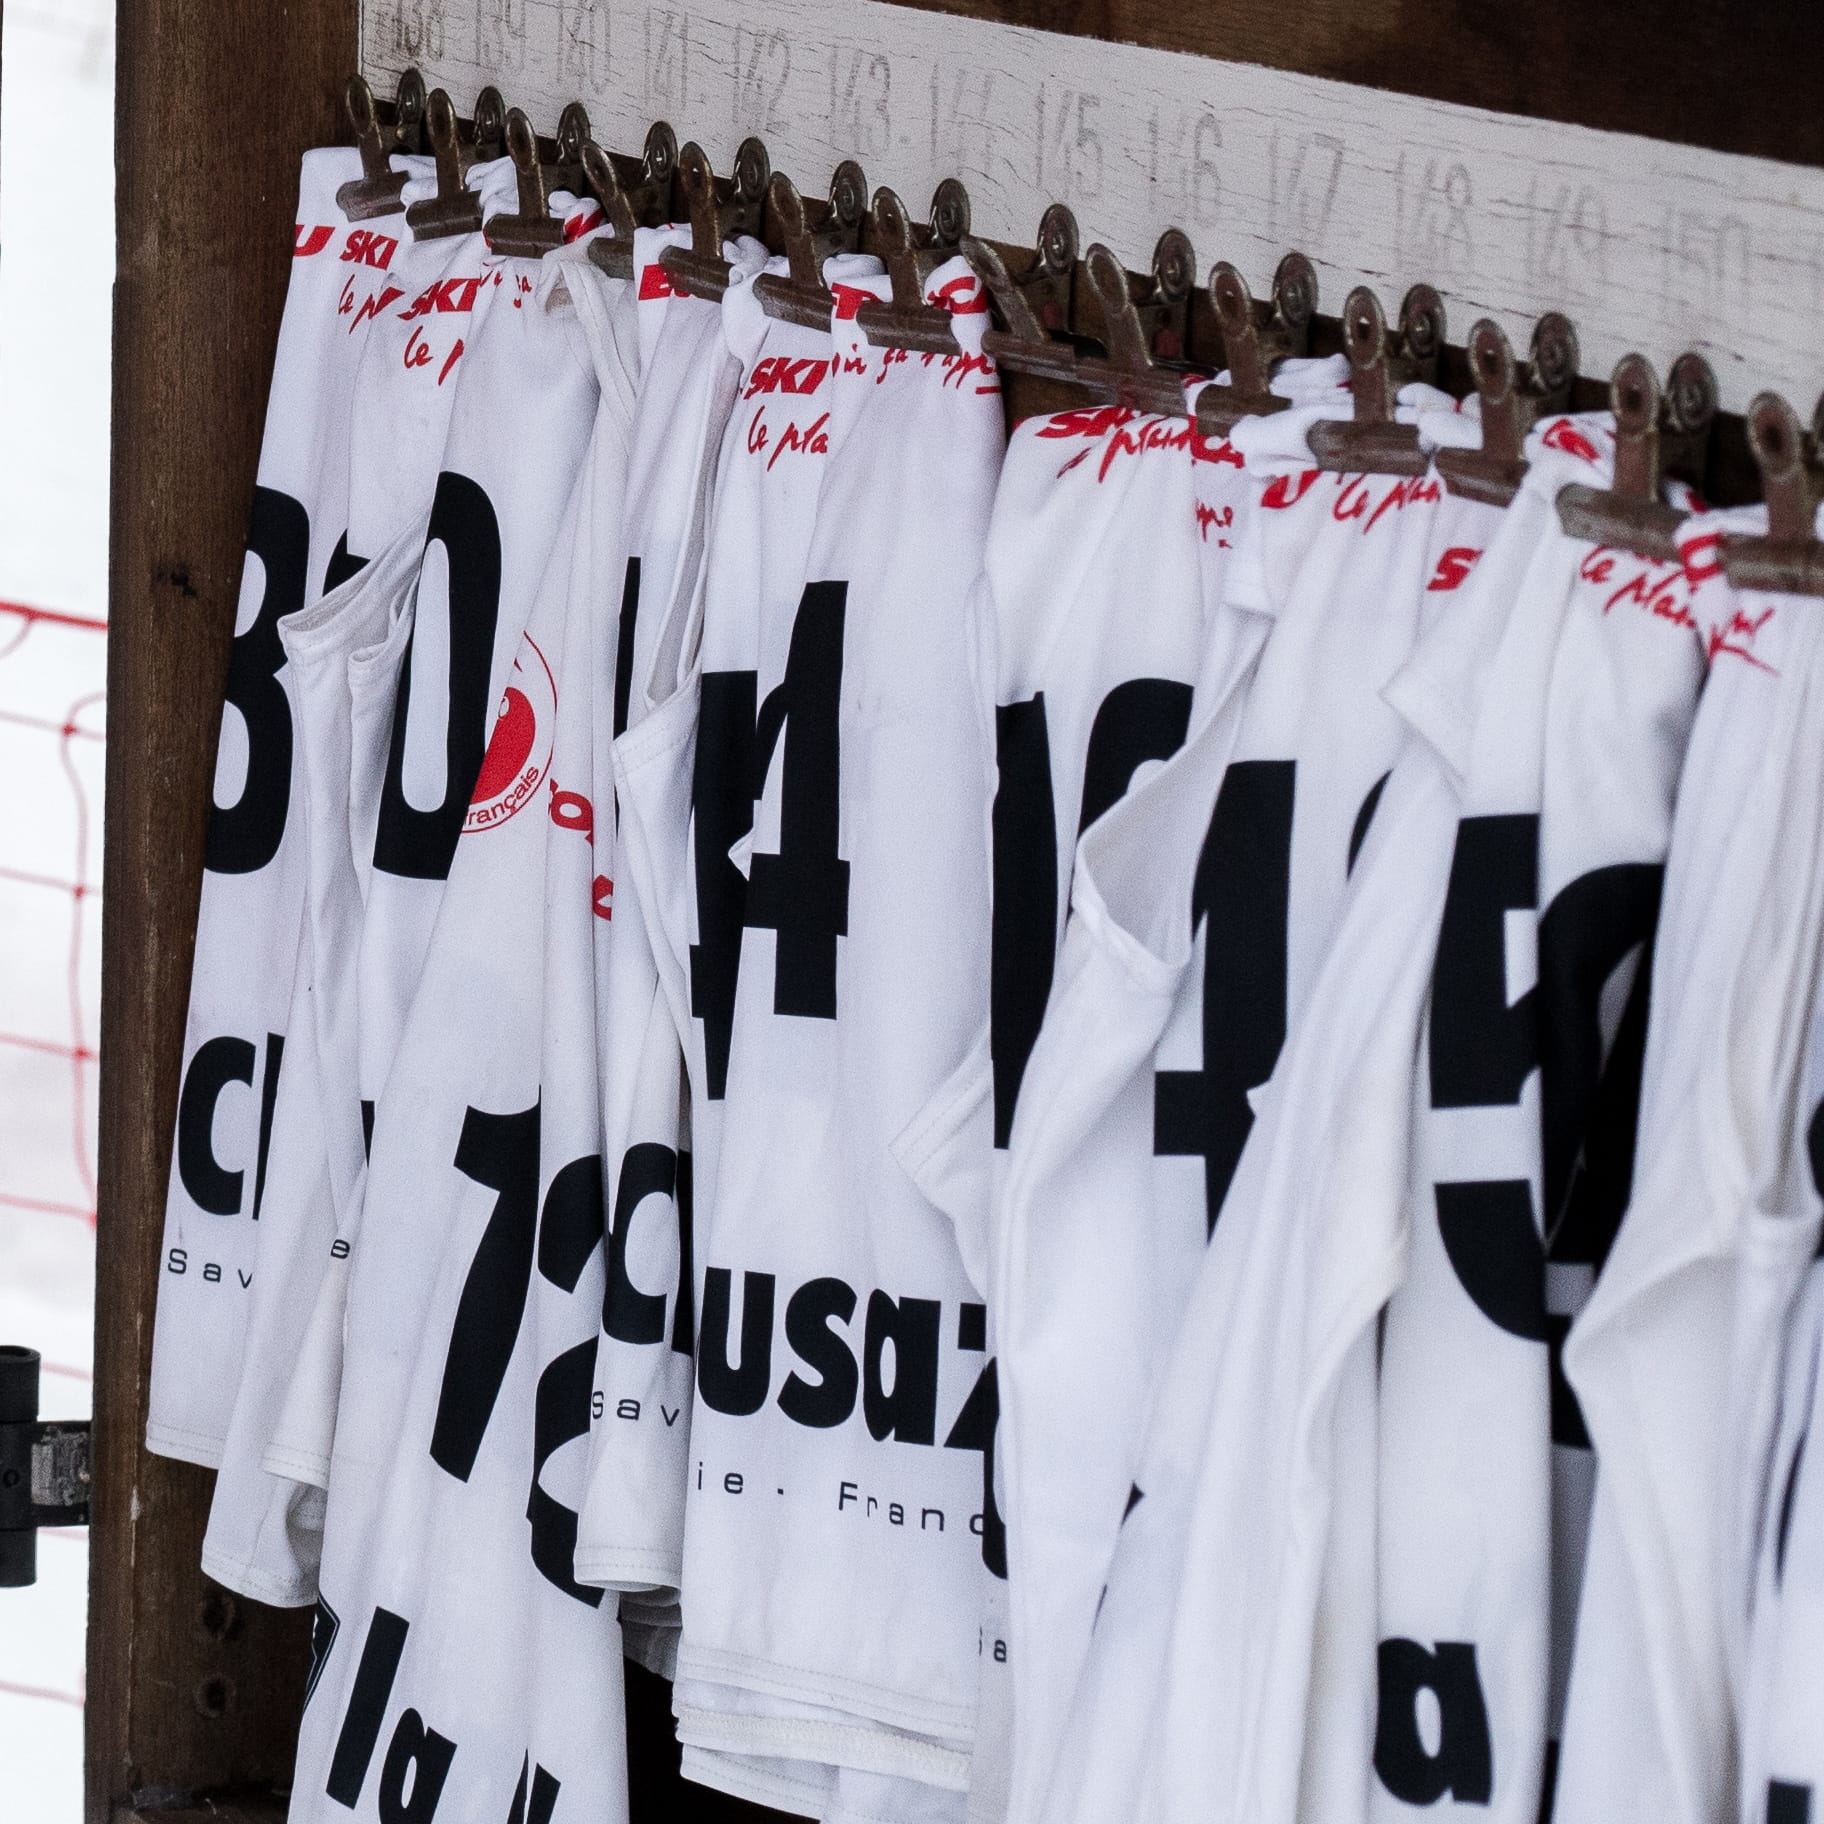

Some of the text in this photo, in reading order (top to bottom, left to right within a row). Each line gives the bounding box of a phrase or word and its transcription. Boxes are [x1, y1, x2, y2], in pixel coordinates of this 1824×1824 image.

[644, 6, 691, 117] 141
[731, 22, 793, 136] 142
[830, 44, 892, 158] 143
[1034, 81, 1104, 203] 145
[1394, 148, 1475, 270] 148
[339, 229, 399, 271] SKI
[403, 325, 434, 369] le
[744, 356, 830, 400] SKI
